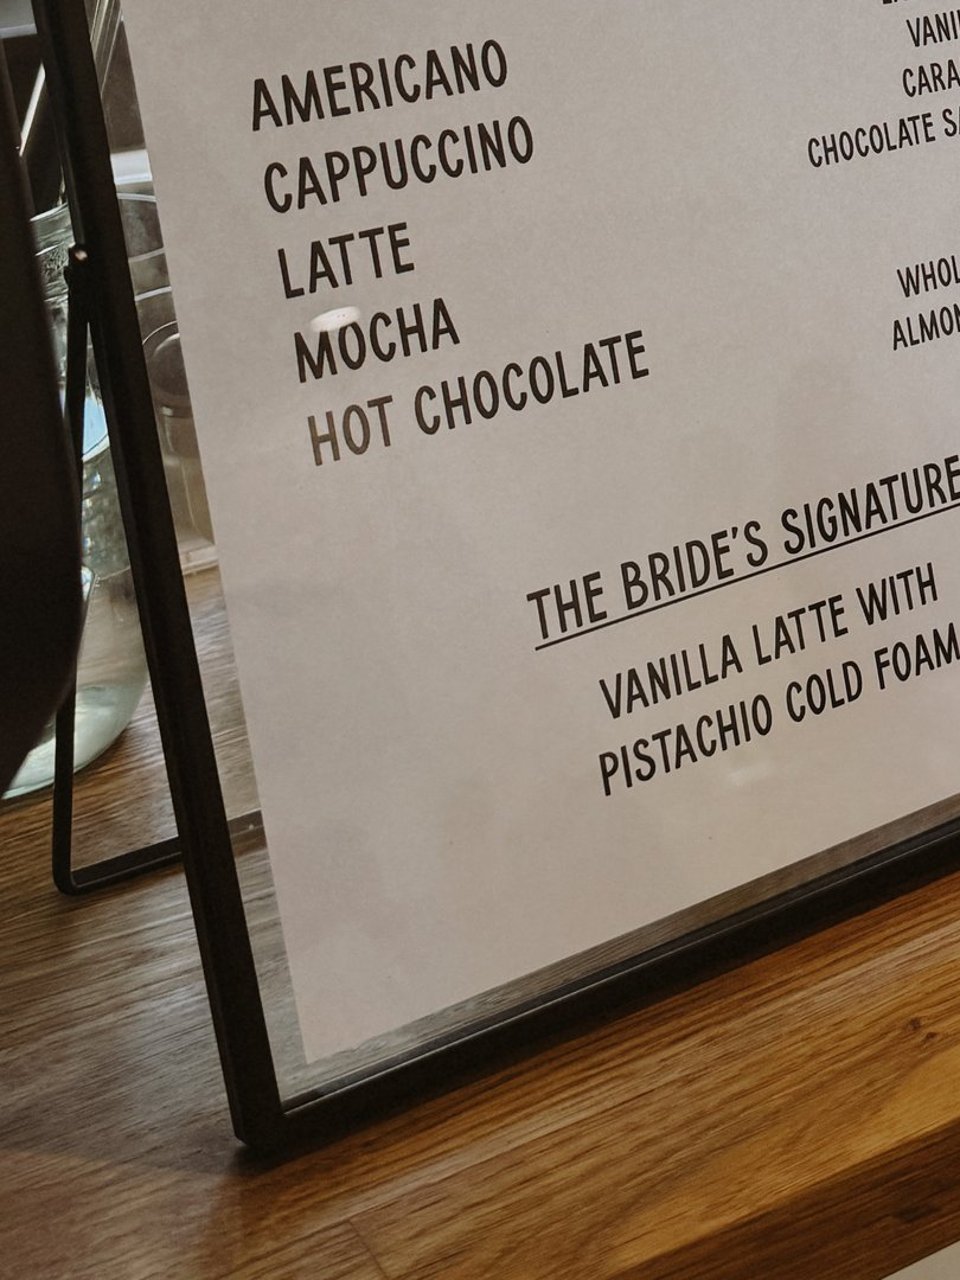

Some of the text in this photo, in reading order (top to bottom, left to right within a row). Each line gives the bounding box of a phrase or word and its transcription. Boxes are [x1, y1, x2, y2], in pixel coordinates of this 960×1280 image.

[252, 39, 507, 132] AMERICANO
[264, 116, 533, 214] CAPPUCCINO
[808, 112, 936, 168] CHOCOLATE
[278, 222, 415, 299] LATTE
[294, 298, 460, 383] MOCHA
[308, 330, 649, 466] HOT CHOCOLATE
[526, 571, 607, 639] THE
[621, 521, 768, 610] BRIDE'S
[599, 562, 938, 719] VANILLA LATTE WITH
[599, 622, 960, 796] PISTACHIO COLD FOAM
